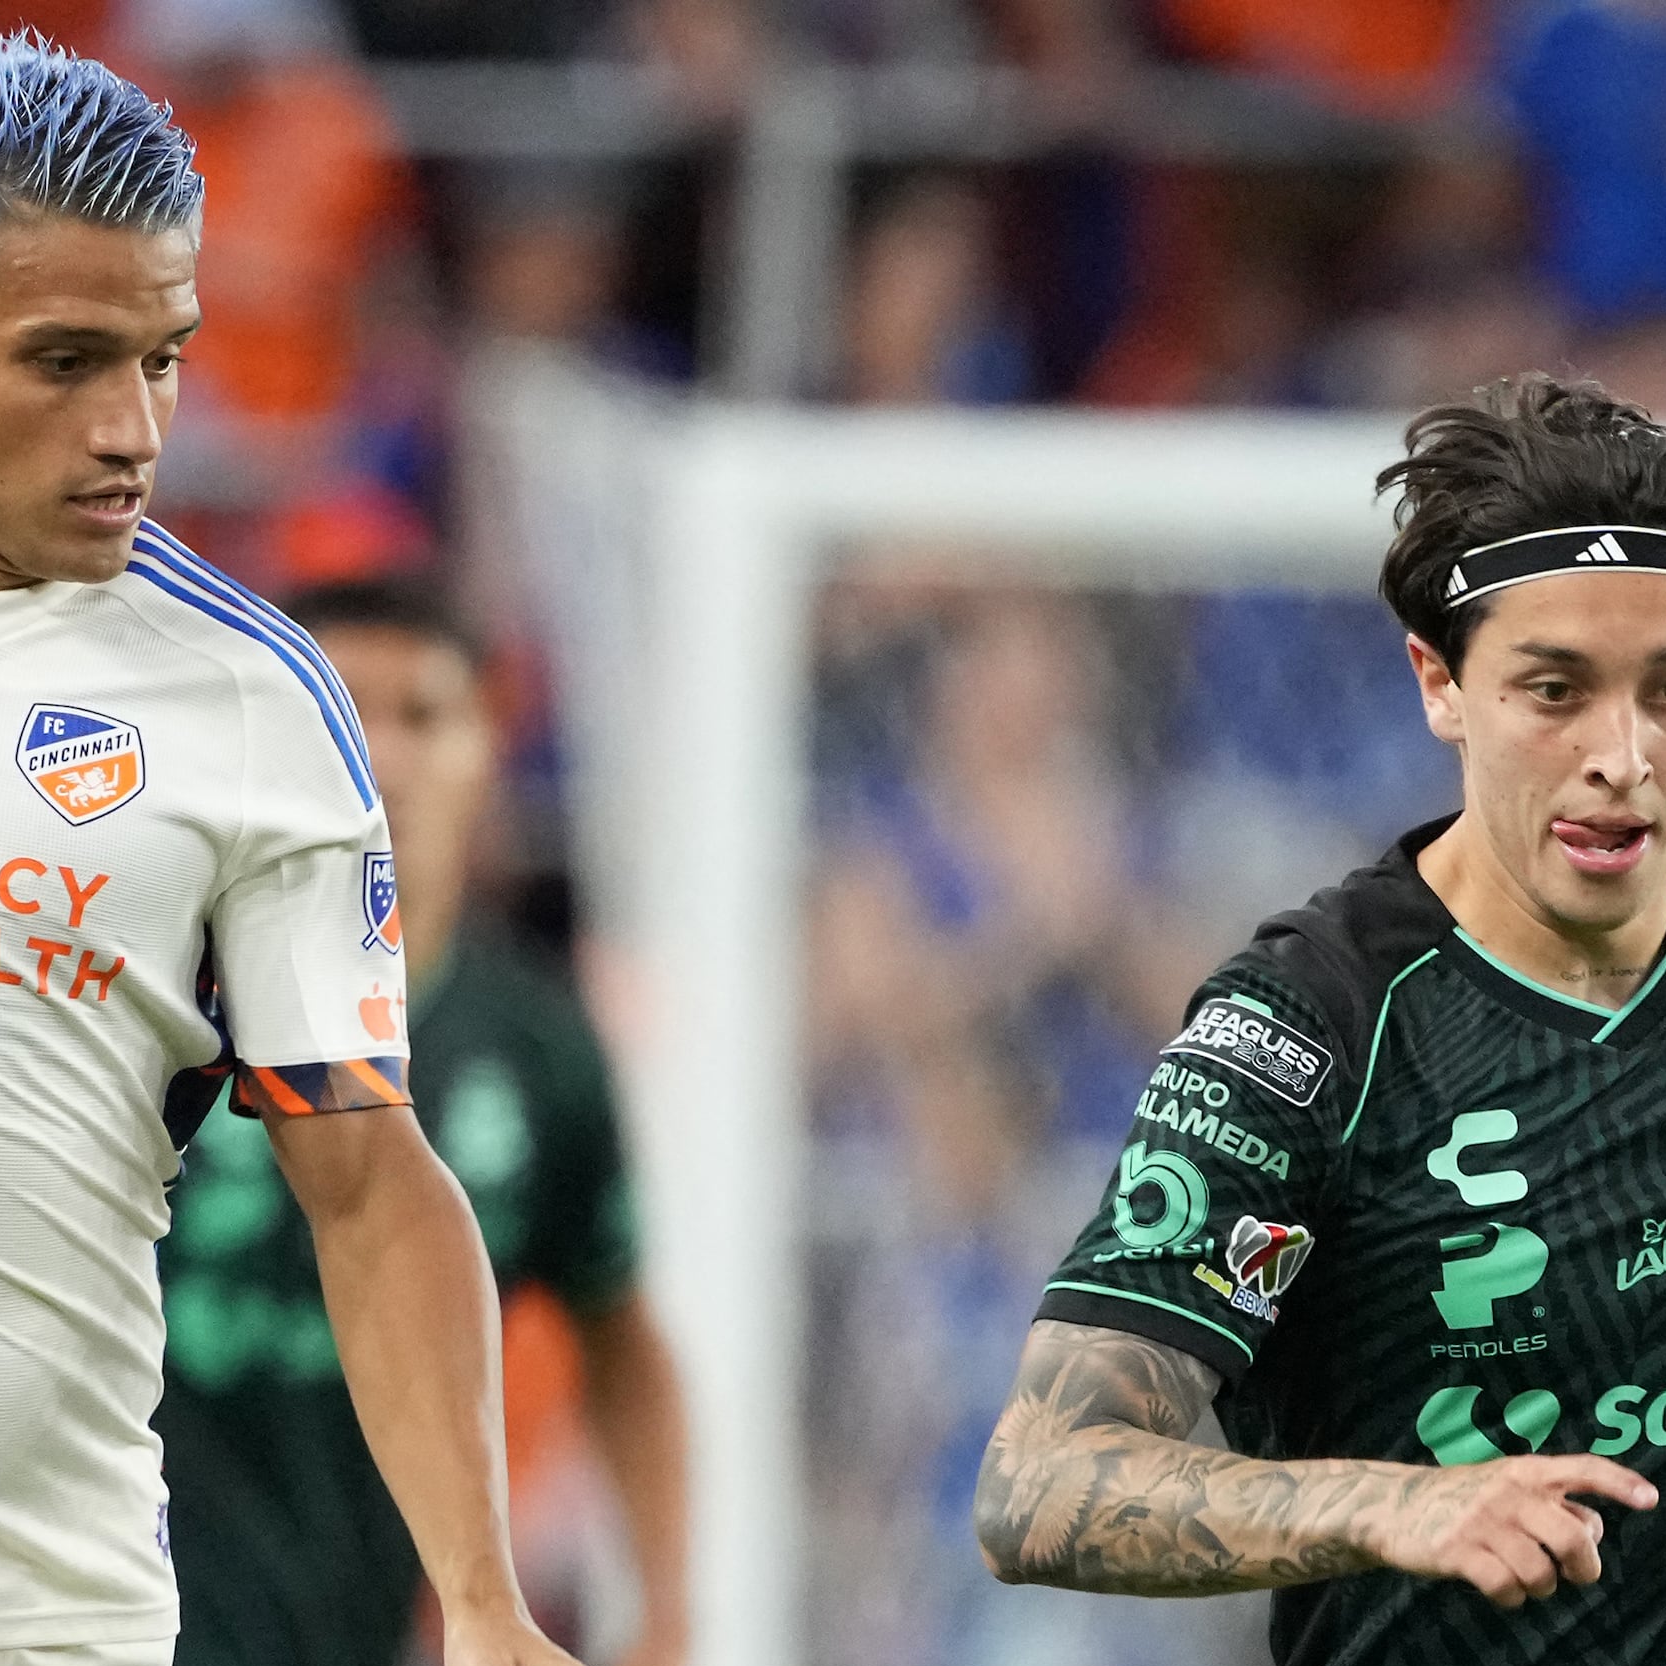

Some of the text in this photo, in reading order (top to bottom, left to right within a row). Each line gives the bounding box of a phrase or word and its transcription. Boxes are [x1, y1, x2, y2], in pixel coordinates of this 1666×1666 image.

[29, 732, 131, 771] CINCINNATI
[43, 716, 65, 735] FC
[373, 862, 395, 884] ML
[1187, 1025, 1309, 1093] CUP 2024
[1197, 1007, 1321, 1076] LEAGUES
[1134, 1089, 1290, 1181] ALAMEDA
